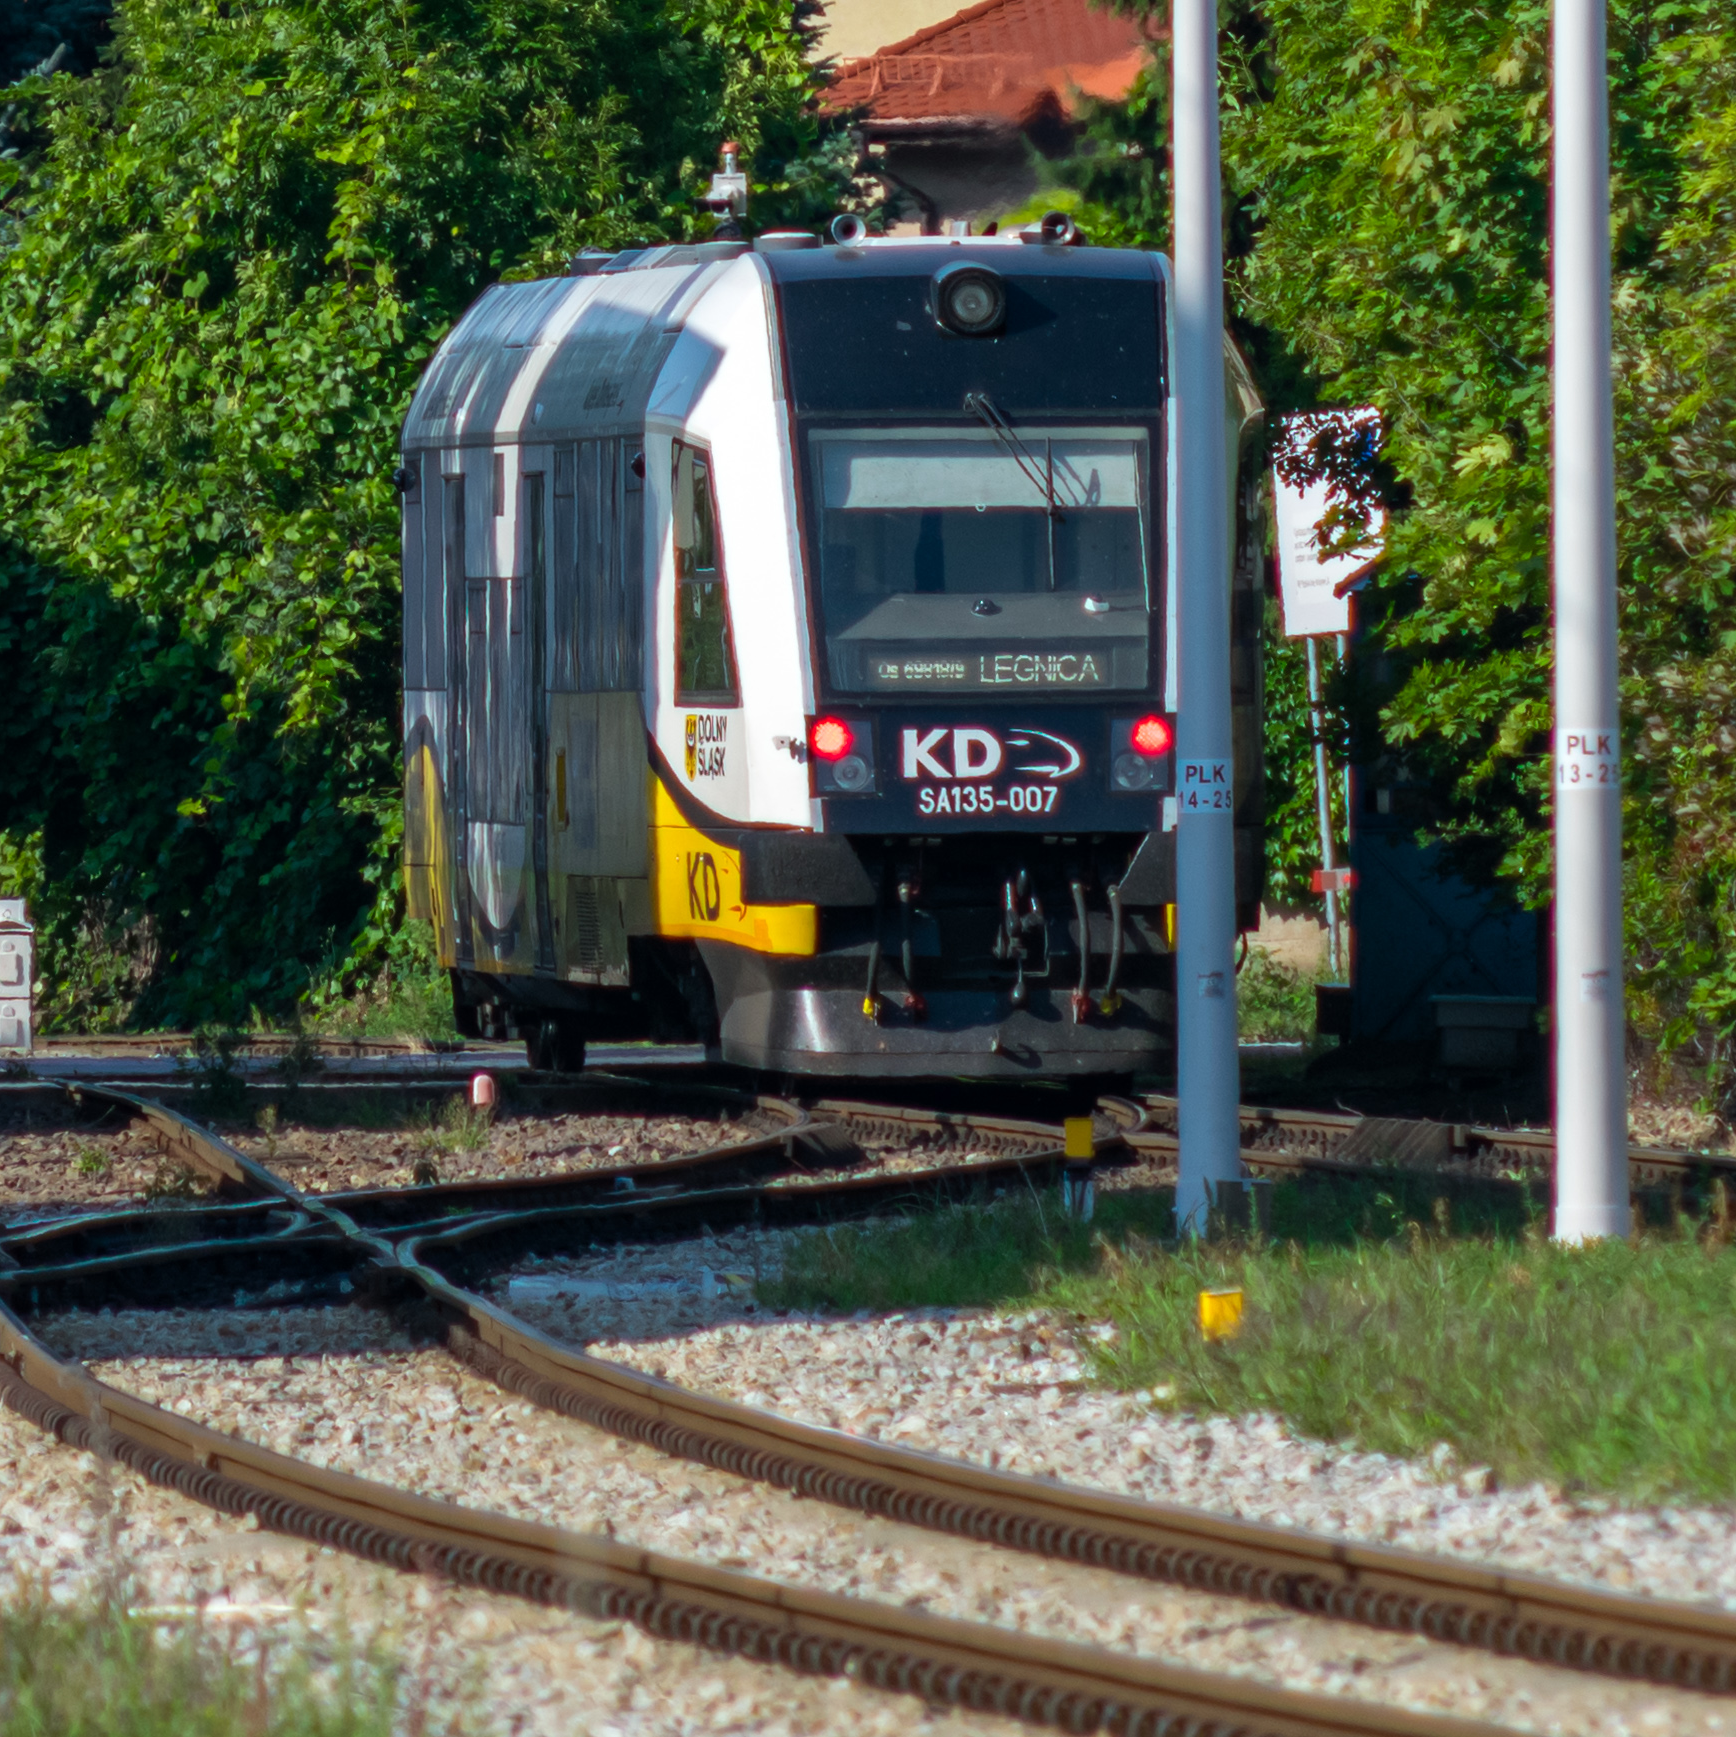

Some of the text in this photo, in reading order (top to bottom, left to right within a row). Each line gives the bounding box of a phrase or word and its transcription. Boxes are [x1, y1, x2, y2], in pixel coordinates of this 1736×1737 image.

[979, 654, 1100, 683] LEGNICA
[698, 714, 728, 743] DOLNY
[902, 728, 1002, 779] KD
[1567, 735, 1612, 756] PLK
[698, 741, 726, 780] ŚLĄSK
[1185, 764, 1226, 784] PLK
[919, 785, 1058, 814] SA135-007
[1178, 789, 1232, 809] 14-25
[686, 851, 721, 922] KD
